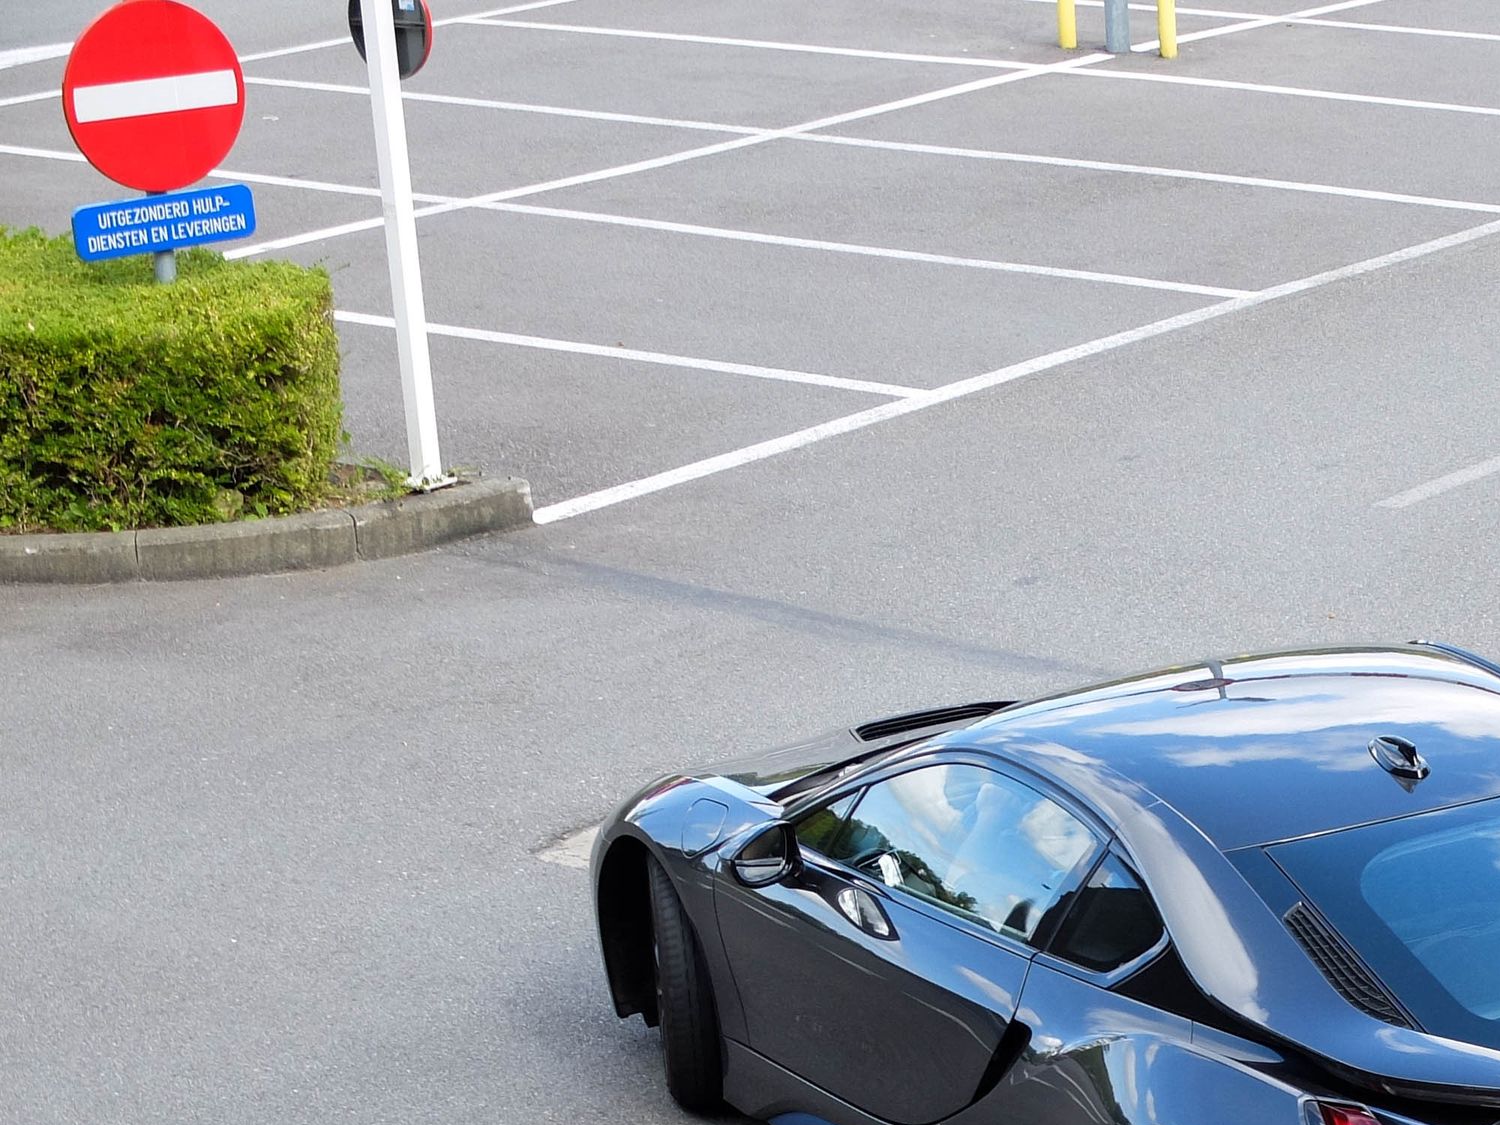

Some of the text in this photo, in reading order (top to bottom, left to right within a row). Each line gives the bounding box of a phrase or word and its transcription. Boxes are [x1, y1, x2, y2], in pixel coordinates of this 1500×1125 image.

[98, 195, 230, 229] UITGEZONDERD HULP-
[88, 214, 246, 253] DIENSTEN EN LEVERINGEN
